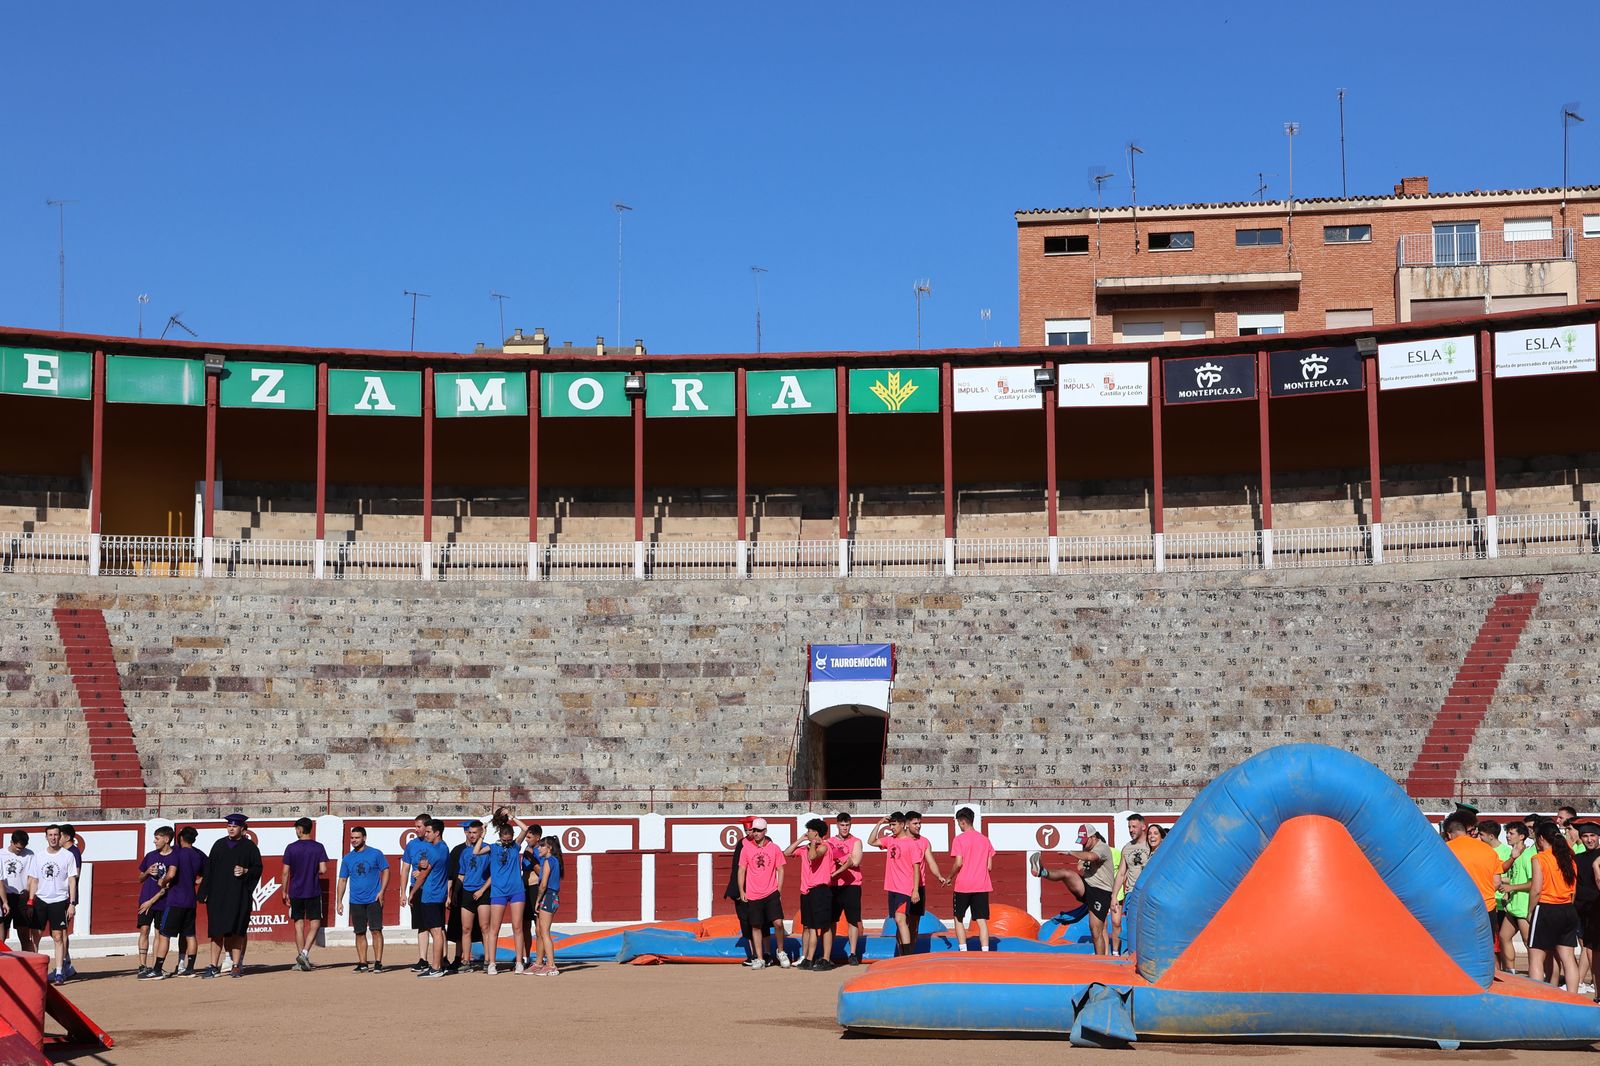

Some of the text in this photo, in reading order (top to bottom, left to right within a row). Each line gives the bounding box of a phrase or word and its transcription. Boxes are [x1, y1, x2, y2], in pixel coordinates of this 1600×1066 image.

[1526, 337, 1561, 350] ESLA
[1408, 349, 1442, 363] ESLA
[830, 656, 887, 668] TAUROEMOCIÓN
[568, 831, 580, 848] 6
[726, 830, 738, 847] 6
[1042, 828, 1054, 846] 7
